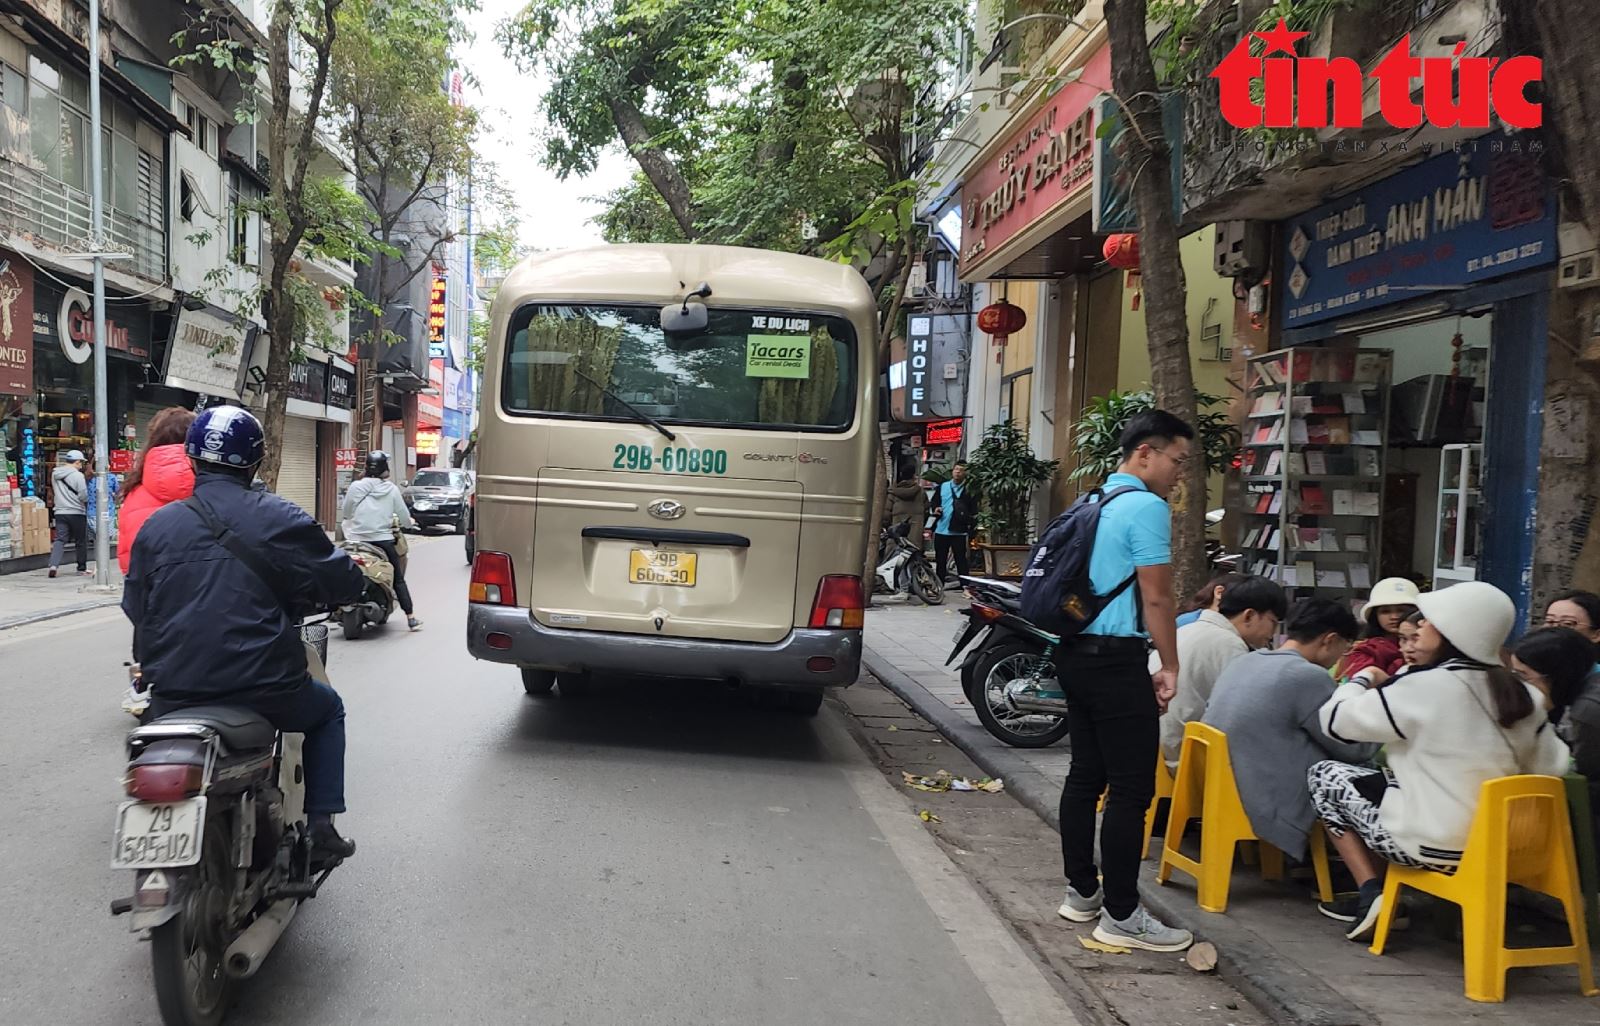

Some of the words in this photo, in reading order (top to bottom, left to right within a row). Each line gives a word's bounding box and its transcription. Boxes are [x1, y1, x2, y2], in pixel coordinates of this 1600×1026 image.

[1385, 196, 1430, 250] ANH
[752, 316, 766, 328] XE
[768, 317, 784, 330] DU
[785, 318, 810, 333] LỊCH
[751, 342, 805, 358] Tacars
[749, 359, 761, 367] Car
[911, 339, 928, 416] HOTEL
[336, 450, 357, 461] SAL
[613, 443, 728, 475] 29B-60890
[149, 805, 174, 833] 29
